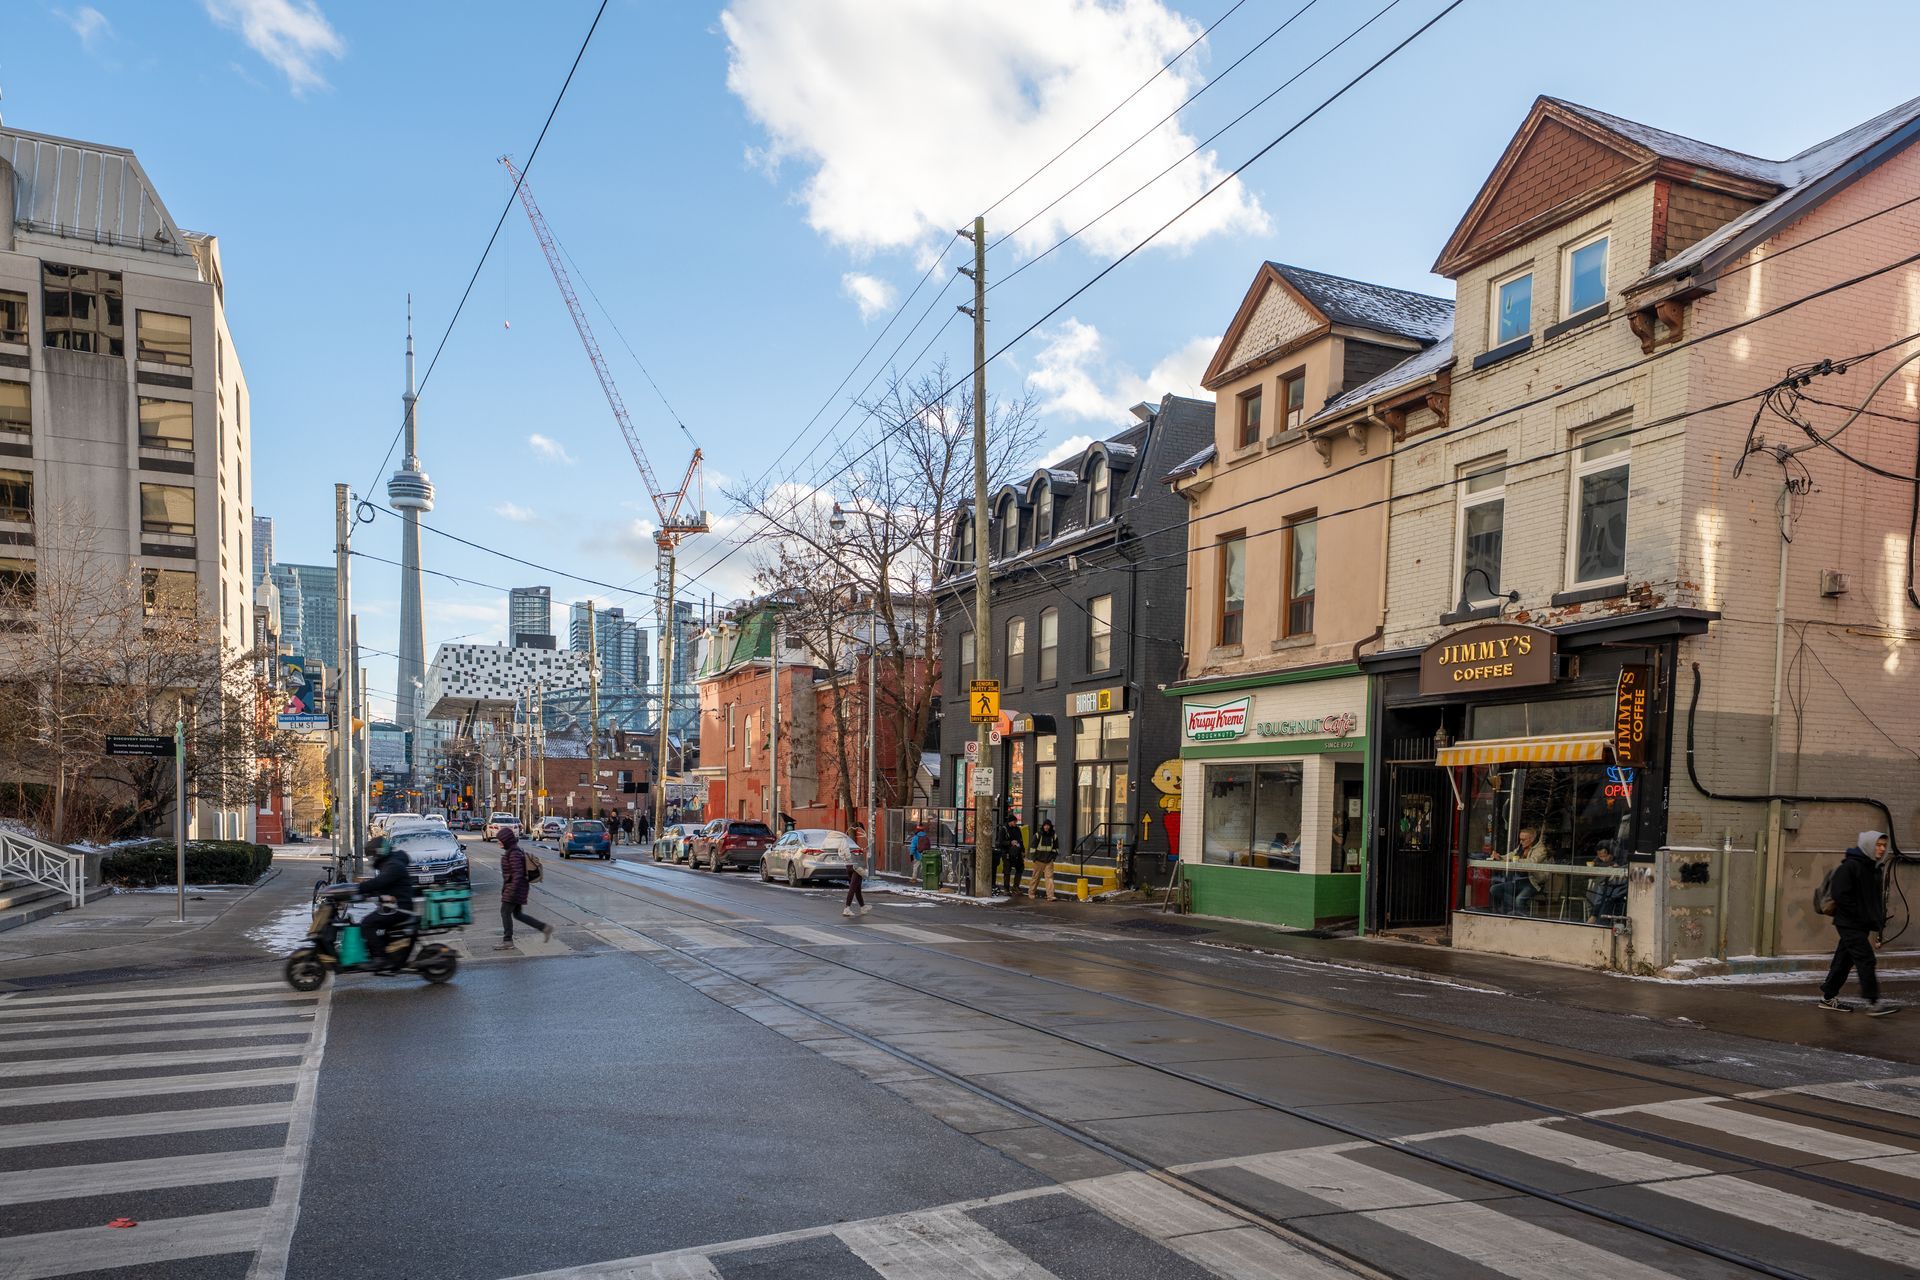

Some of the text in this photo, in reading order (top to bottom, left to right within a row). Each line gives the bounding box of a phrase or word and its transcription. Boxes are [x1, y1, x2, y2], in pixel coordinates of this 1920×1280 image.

[1438, 635, 1532, 665] JIMMY'S
[1453, 663, 1513, 681] COFFEE
[1076, 692, 1097, 713] BURGER
[1189, 708, 1245, 731] Krispy Kreme
[1256, 712, 1352, 738] DOUGHNUT Café
[1618, 671, 1635, 760] JIMMY'S
[1633, 689, 1645, 742] COFFEE
[1197, 731, 1233, 740] DOUGHNUTS
